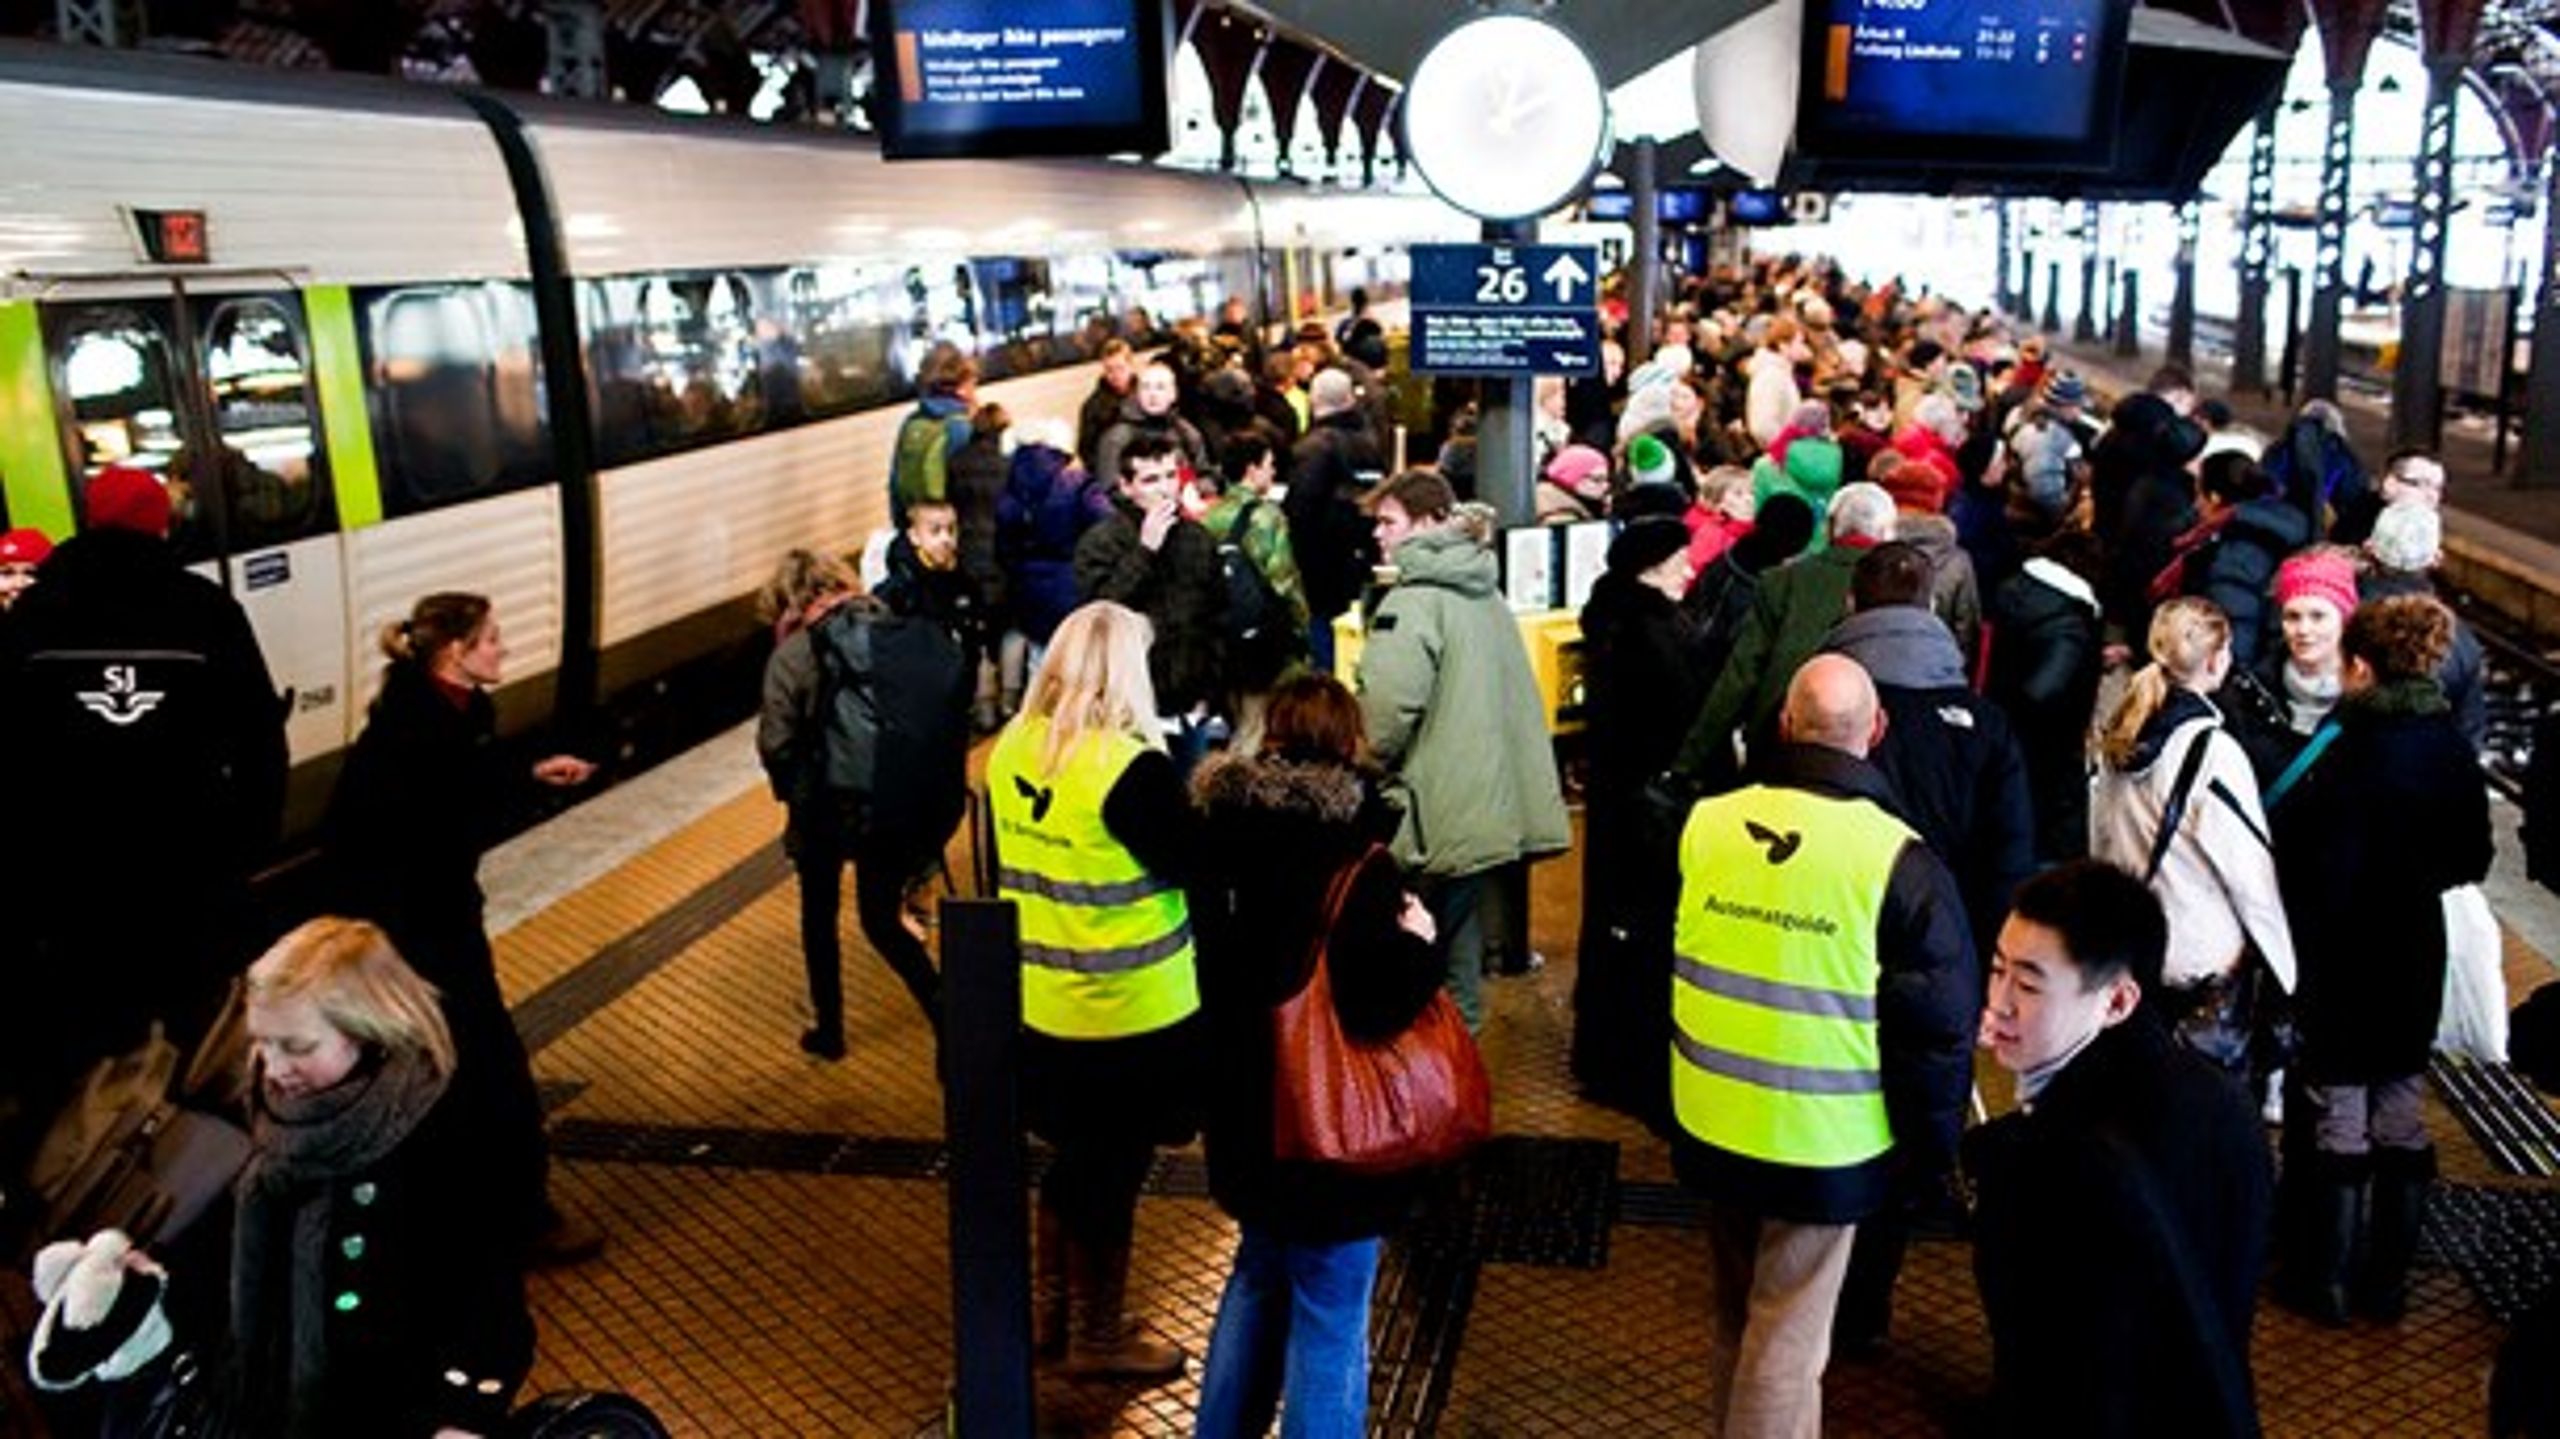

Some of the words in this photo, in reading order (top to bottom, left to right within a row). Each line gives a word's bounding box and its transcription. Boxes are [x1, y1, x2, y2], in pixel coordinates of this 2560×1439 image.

[1476, 266, 1528, 303] 26
[104, 664, 136, 693] SJ
[1703, 894, 1840, 936] Automatguide
